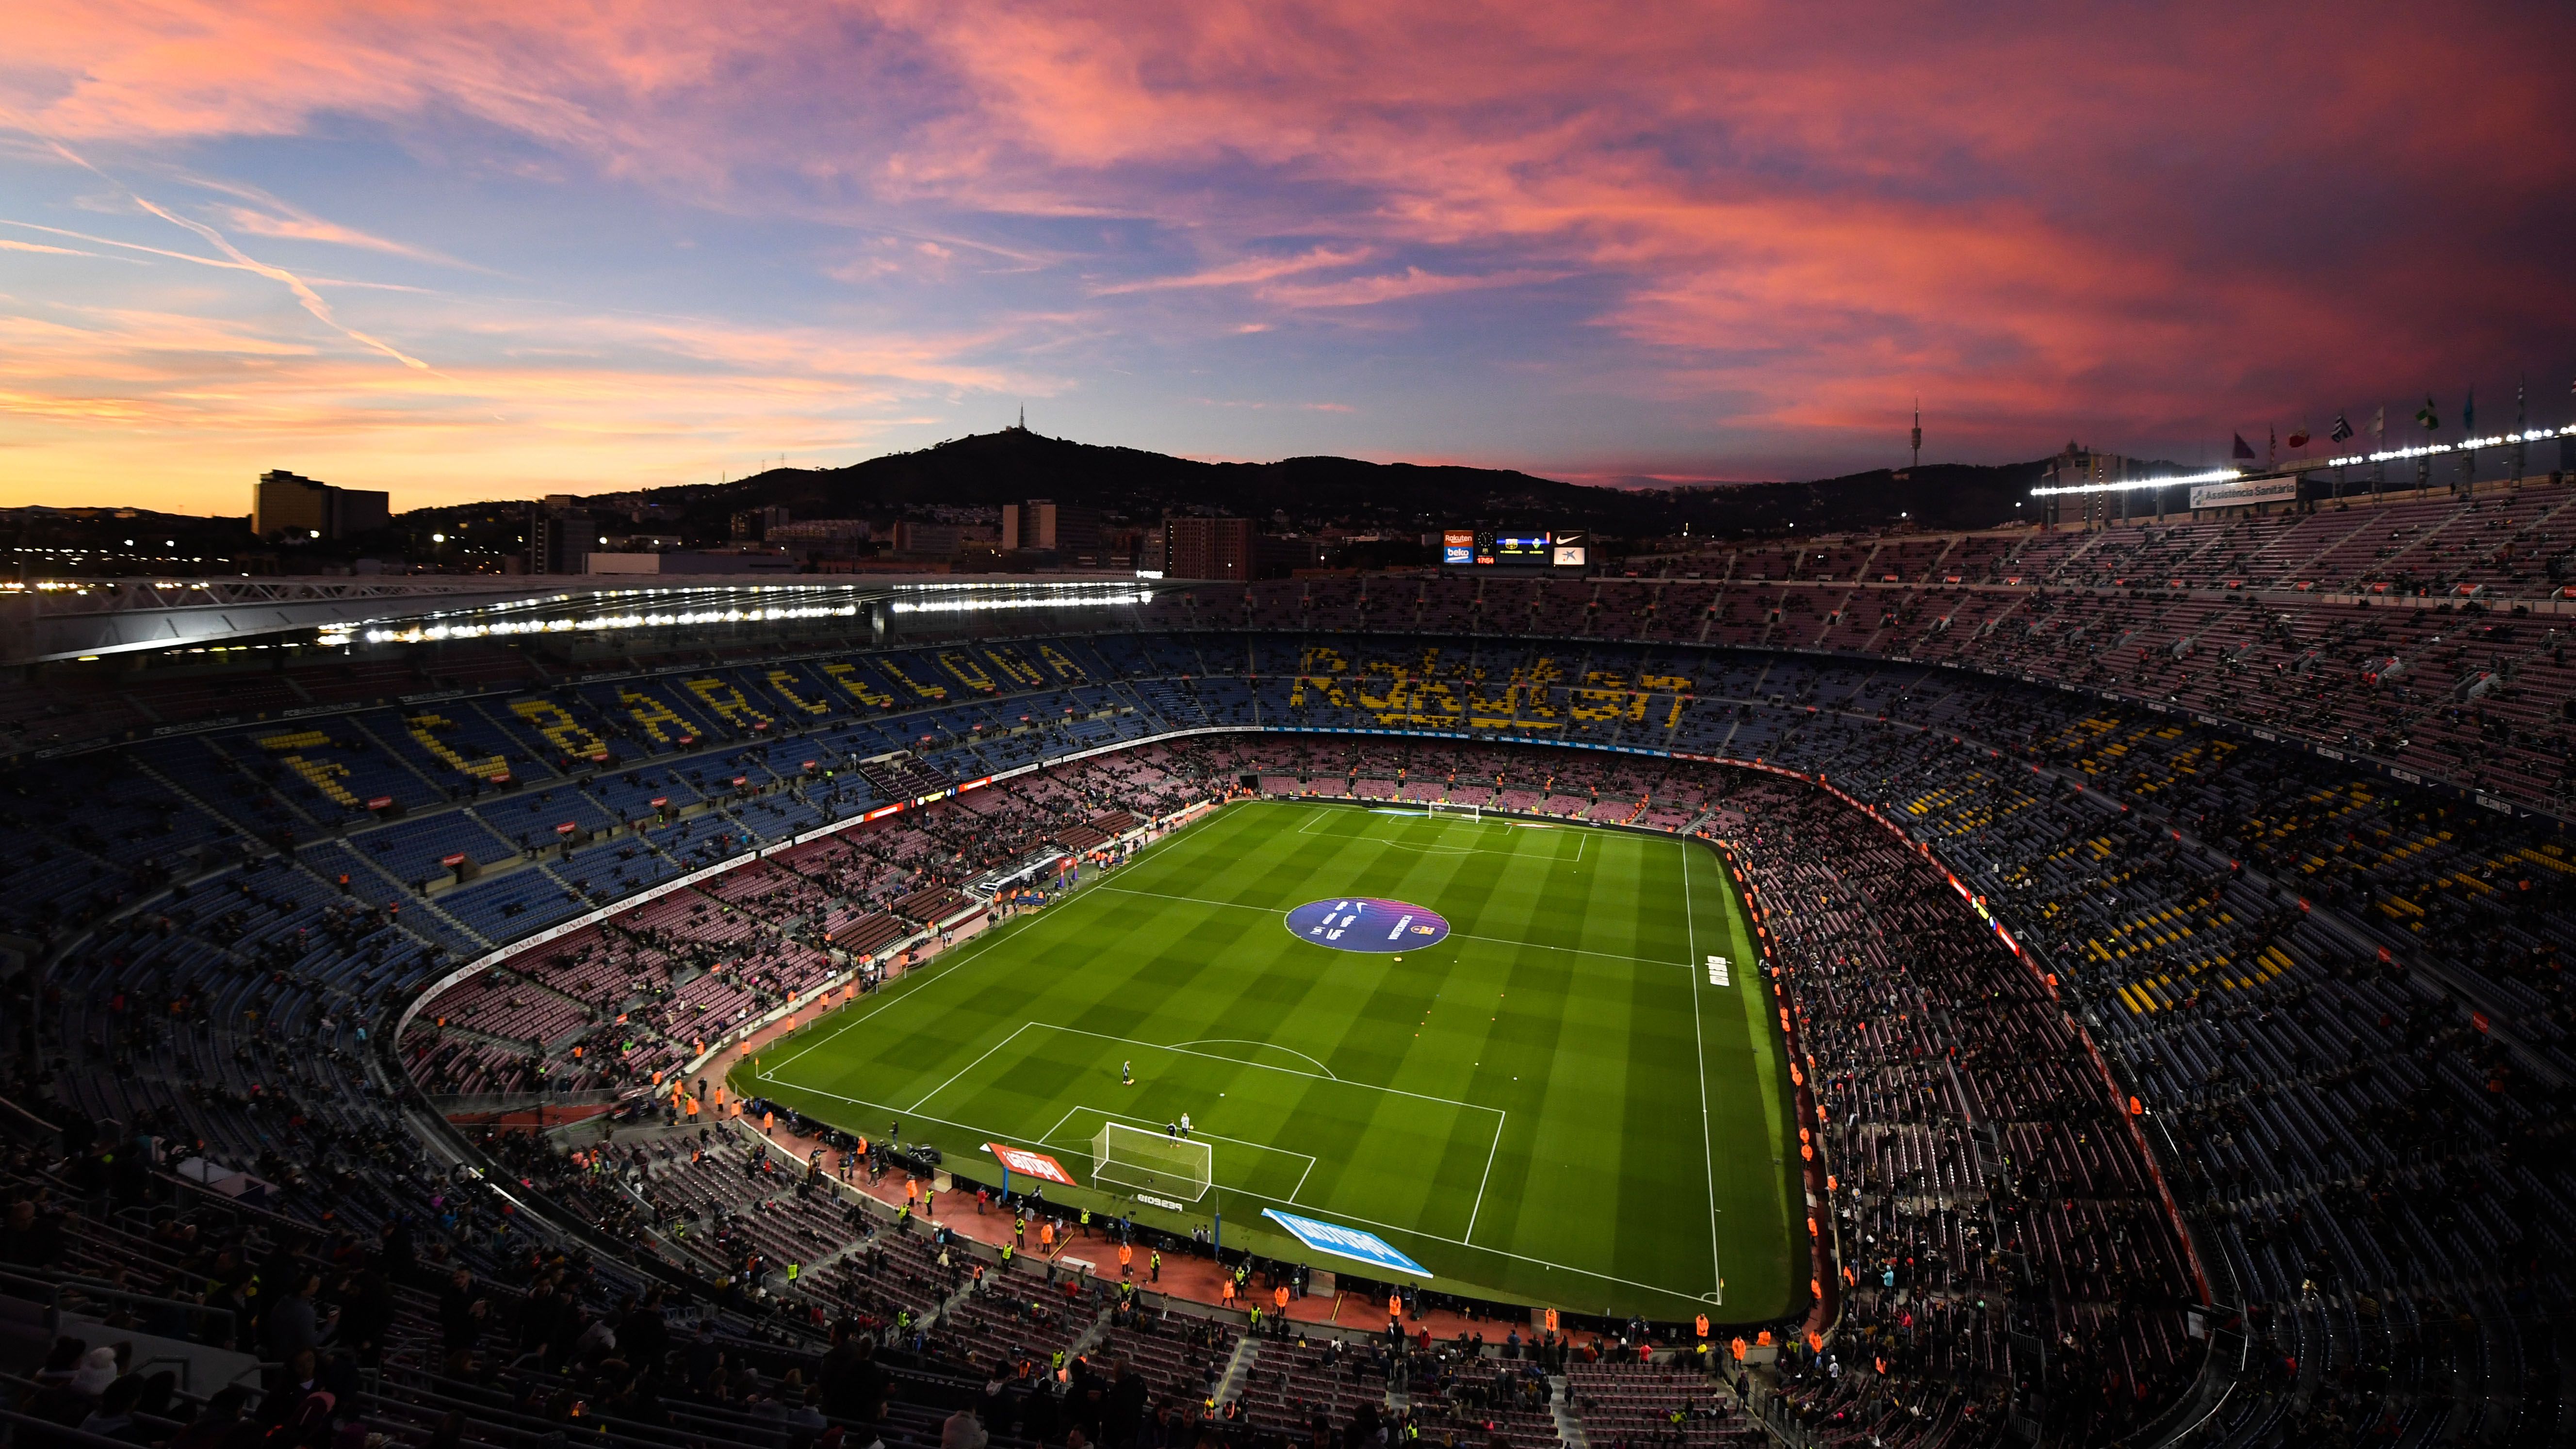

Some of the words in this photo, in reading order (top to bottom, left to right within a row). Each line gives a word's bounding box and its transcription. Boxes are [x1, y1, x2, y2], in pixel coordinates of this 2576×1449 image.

[1448, 548, 1469, 556] beko
[1045, 758, 1060, 766] KONAMI
[1065, 752, 1081, 761] KONAMI
[997, 771, 1013, 780] KONAMI
[834, 817, 856, 830] KONAMI
[804, 828, 827, 841] KONAMI
[764, 842, 789, 857] KONAMI
[725, 854, 752, 869] KONAMI
[687, 867, 716, 882] KONAMI
[648, 881, 678, 899] KONAMI
[603, 897, 636, 916] KONAMI
[556, 915, 592, 935] KONAMI
[504, 935, 543, 956] KONAMI
[1003, 1151, 1065, 1182] Rakuten
[1281, 1215, 1412, 1266] beko.com
